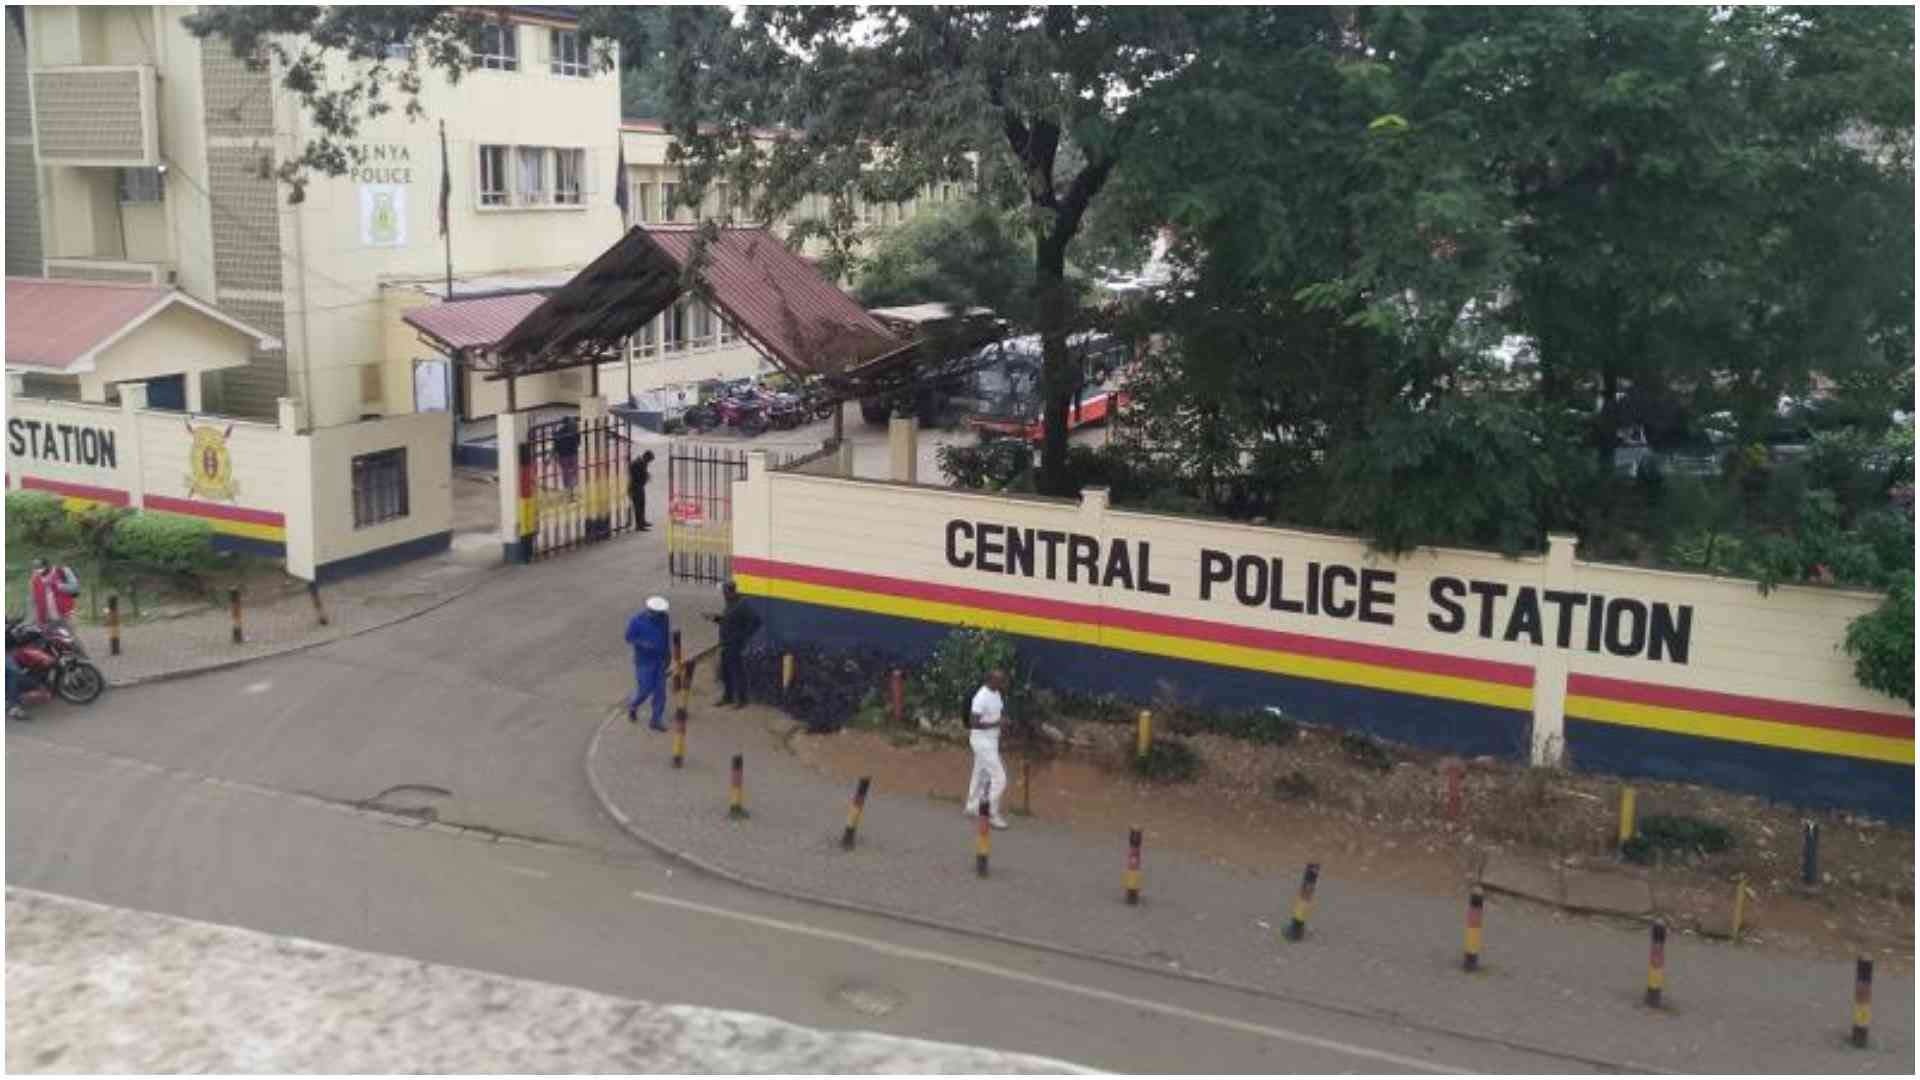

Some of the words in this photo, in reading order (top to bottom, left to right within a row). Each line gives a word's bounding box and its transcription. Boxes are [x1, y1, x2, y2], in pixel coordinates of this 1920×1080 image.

[351, 144, 411, 161] ENYA
[351, 167, 416, 184] POLICE
[8, 418, 116, 469] STATION
[945, 519, 1171, 596] CENTRAL
[1200, 549, 1397, 626] POLICE
[1428, 576, 1694, 665] STATION
